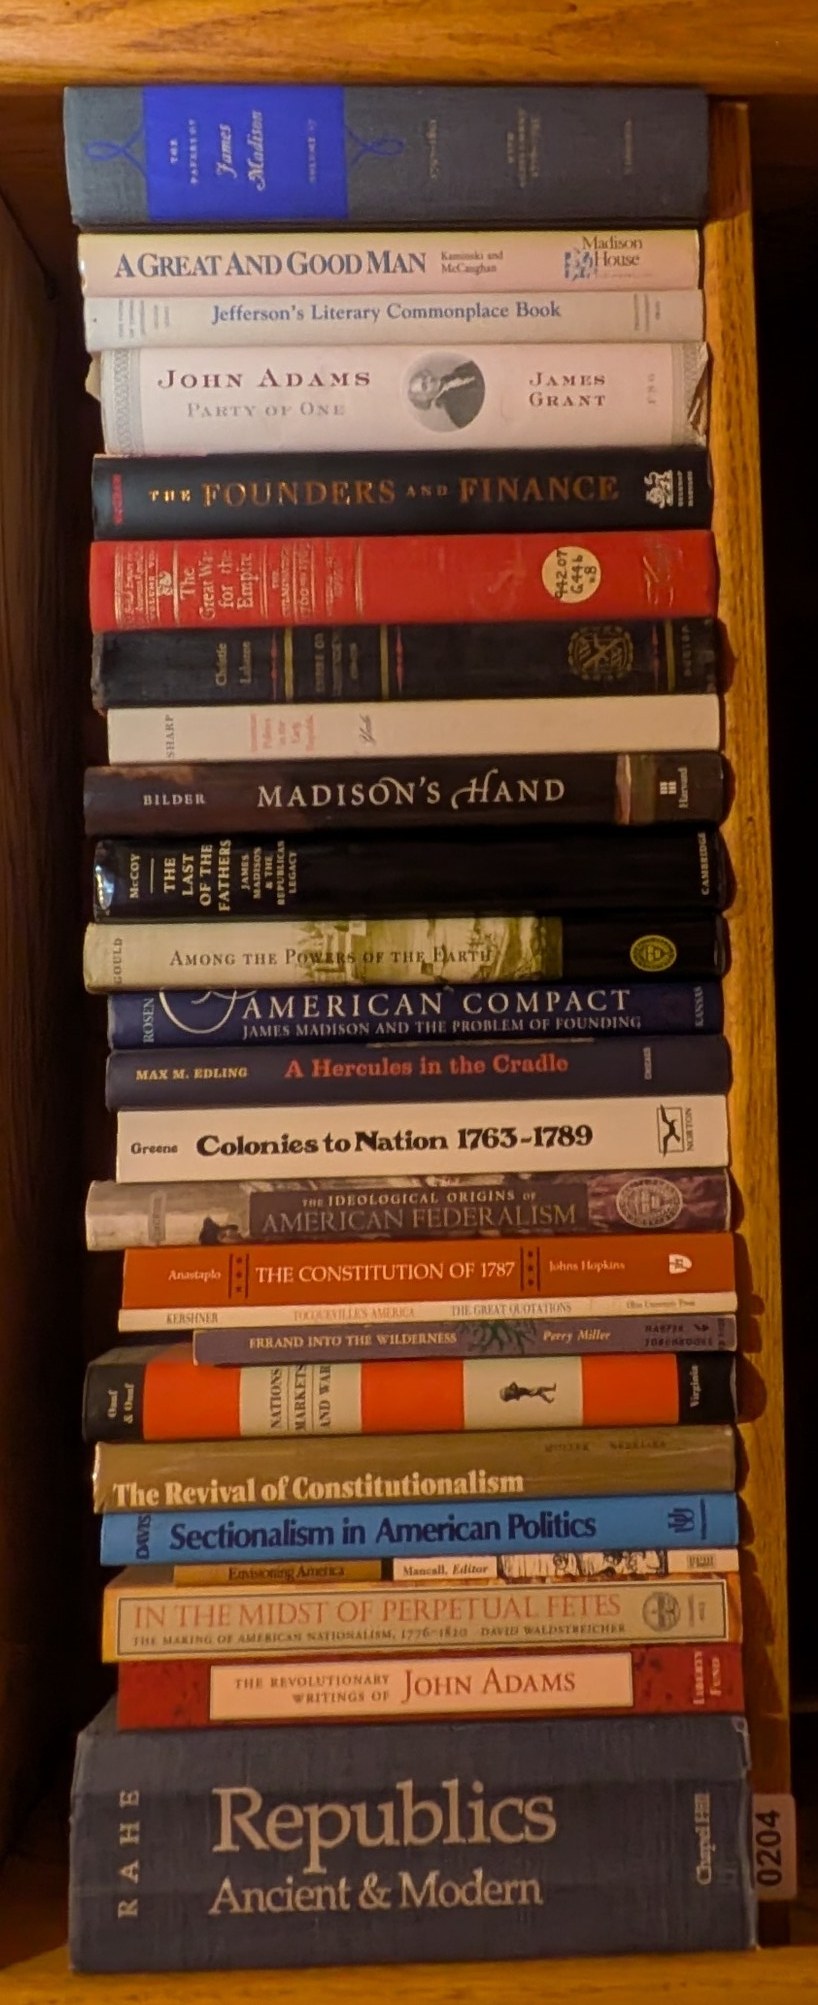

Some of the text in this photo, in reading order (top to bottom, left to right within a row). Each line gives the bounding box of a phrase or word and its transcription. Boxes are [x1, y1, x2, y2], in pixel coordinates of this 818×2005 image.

[170, 138, 178, 165] THE
[215, 124, 237, 178] James
[246, 110, 266, 191] Madison
[441, 250, 503, 261] Kaminski and
[582, 236, 643, 250] Madison
[595, 251, 640, 267] House
[114, 250, 426, 278] A GREAT AND GOOD MAN
[441, 262, 497, 275] McCaughan
[211, 301, 561, 324] Jefferson's Literary Commonplace Book
[157, 368, 371, 390] JOHN ADAMS
[529, 372, 606, 387] JAMES
[529, 392, 606, 407] GRANT
[148, 475, 620, 507] THE FOUNDERS AND FINANCE
[180, 568, 195, 601] The
[555, 549, 568, 599] 942.07
[198, 580, 216, 620] Great
[218, 584, 234, 608] for
[215, 642, 227, 686] Christie
[165, 714, 175, 758] SHARP
[143, 793, 205, 806] BILDER
[257, 767, 565, 810] MADISON'S HAND
[679, 767, 688, 808] Harvard
[129, 853, 140, 899] McCOY
[164, 857, 176, 893] THE
[182, 853, 194, 896] LAST
[199, 844, 213, 907] OF THE
[218, 839, 232, 912] FATHERS
[241, 855, 250, 890] JAMES
[253, 847, 262, 899] MADISON
[265, 855, 273, 880] THE
[288, 851, 297, 893] LEGACY
[113, 938, 123, 984] GOULD
[170, 947, 491, 967] AMONG THE POWERS OF THE EARTH
[143, 997, 155, 1043] ROSEN
[241, 989, 630, 1019] AMERICAN COMPACT
[242, 1016, 641, 1040] JAMES MADISON AND THE PROBLEM OF FOUNDING
[136, 1067, 247, 1081] MAX M. EDLING
[284, 1052, 568, 1079] A Hercules in the Cradle
[196, 1125, 594, 1157] Colonies to Nation 1763-1789
[685, 1107, 694, 1151] NORTON
[131, 1142, 178, 1155] Greene
[328, 1192, 439, 1207] IDEOLOGICAL
[447, 1190, 515, 1203] ORIGINS
[263, 1204, 576, 1233] AMERICAN FEDERALISM
[168, 1268, 222, 1282] Anastaplo
[255, 1261, 516, 1283] THE CONSTITUTION OF 1787
[549, 1259, 626, 1274] Johns Hopkins
[166, 1313, 219, 1325] KERSHNER
[452, 1300, 573, 1316] THE GREAT QUOTATIONS
[249, 1332, 457, 1350] ERRAND INTO THE WILDERNESS
[543, 1329, 611, 1343] Perry Miller
[270, 1368, 282, 1429] NATIONS
[295, 1364, 307, 1431] MARKETS
[319, 1364, 331, 1428] AND WAR
[690, 1364, 699, 1408] Virginia
[112, 1470, 524, 1508] The Revival of Constitutionalism
[136, 1514, 151, 1560] DAVIS
[169, 1510, 597, 1551] Sectionalism in American Politics
[229, 1565, 345, 1581] Envisioning America
[403, 1563, 489, 1576] Mancall, Editor
[135, 1593, 622, 1629] IN THE MIDST OF PERPETUAL FETES
[162, 1635, 212, 1646] MAKING
[217, 1634, 232, 1644] OF
[238, 1632, 302, 1643] AMERICAN
[481, 1623, 626, 1636] DAVID WALDSTREICHER
[234, 1674, 390, 1690] THE REVOLUTIONARY
[292, 1690, 390, 1705] WRITINGS OF
[401, 1667, 575, 1704] JOHN ADAMS
[211, 1778, 556, 1874] Republics
[694, 1792, 717, 1885] Chapel Hill
[755, 1810, 782, 1887] 0204
[208, 1866, 544, 1915] Ancient & Modern
